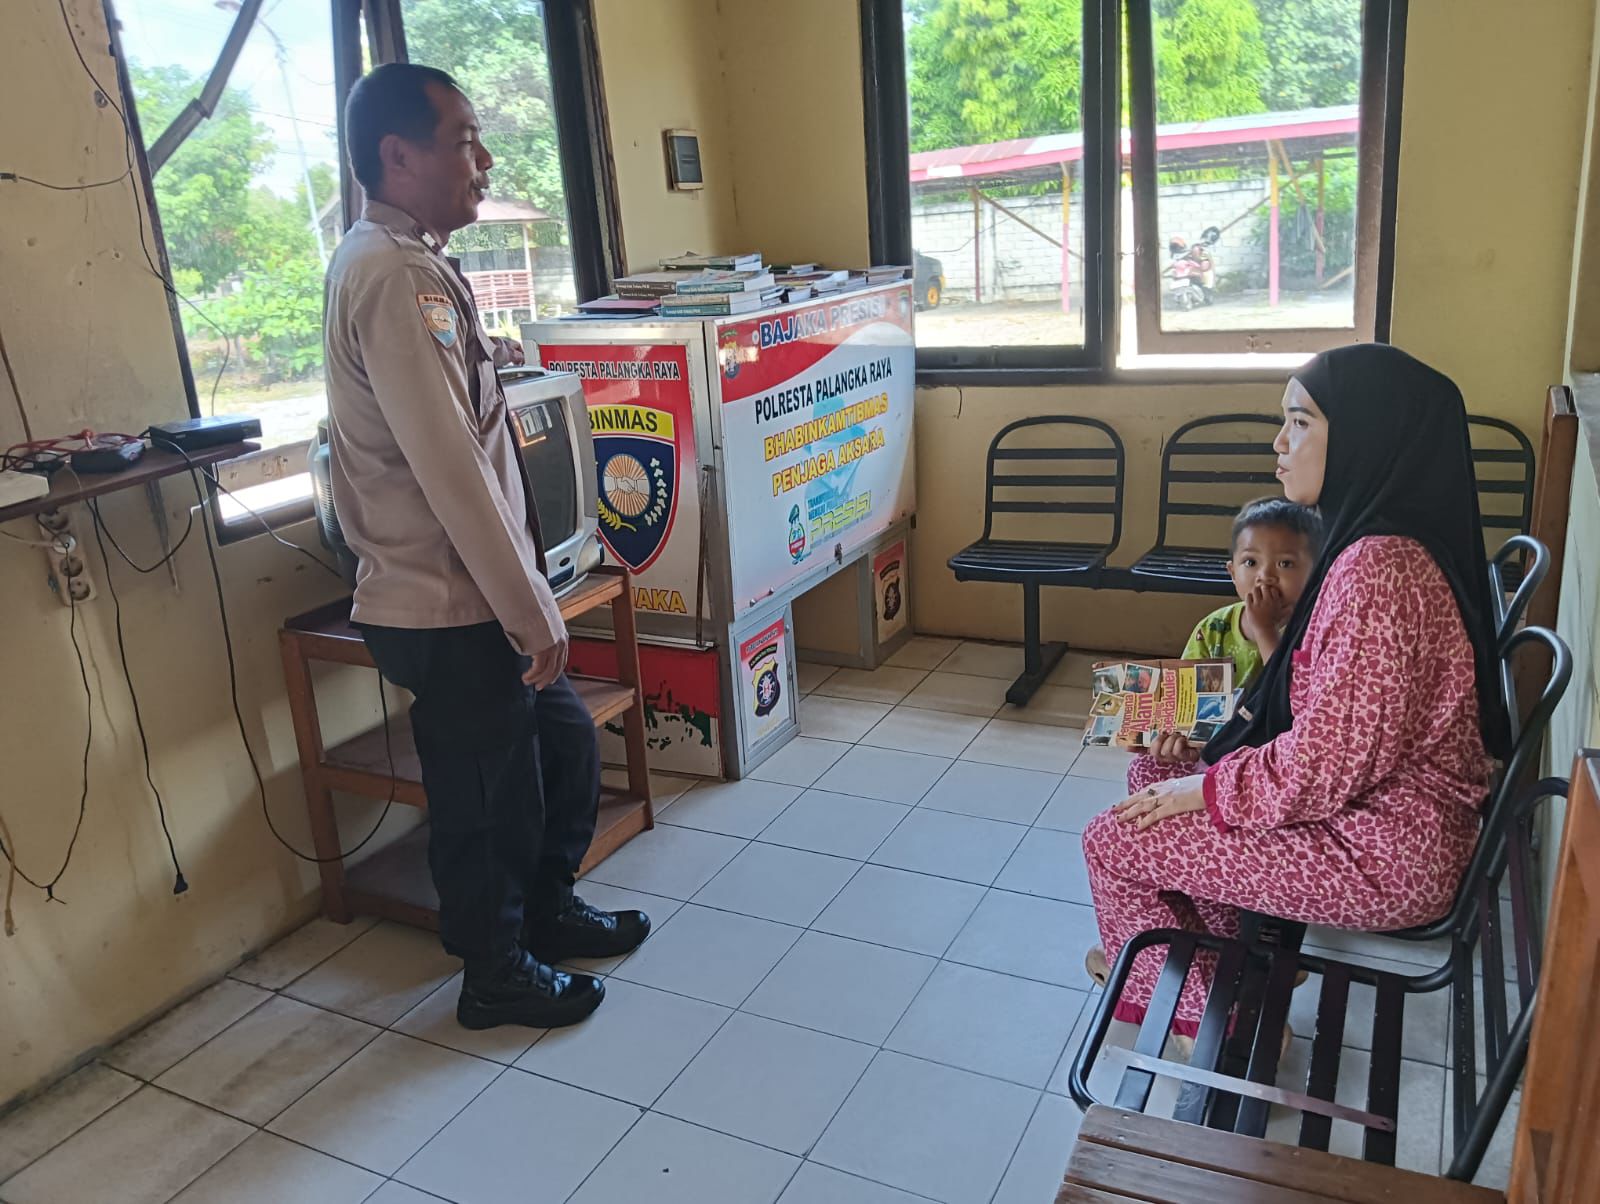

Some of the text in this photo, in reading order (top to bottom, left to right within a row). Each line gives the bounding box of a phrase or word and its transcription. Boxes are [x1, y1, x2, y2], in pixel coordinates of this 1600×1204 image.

[760, 307, 826, 349] BAJAKA
[599, 361, 652, 379] PALANGKA
[653, 362, 681, 380] RAYA
[755, 356, 892, 424] POLRESTA PALANGKA RAYA
[763, 392, 889, 462] BHABINKAMTIBMAS
[772, 428, 885, 497] PENJAGA AKSARA
[1119, 694, 1134, 737] Fenomena
[1130, 693, 1153, 732] Alam
